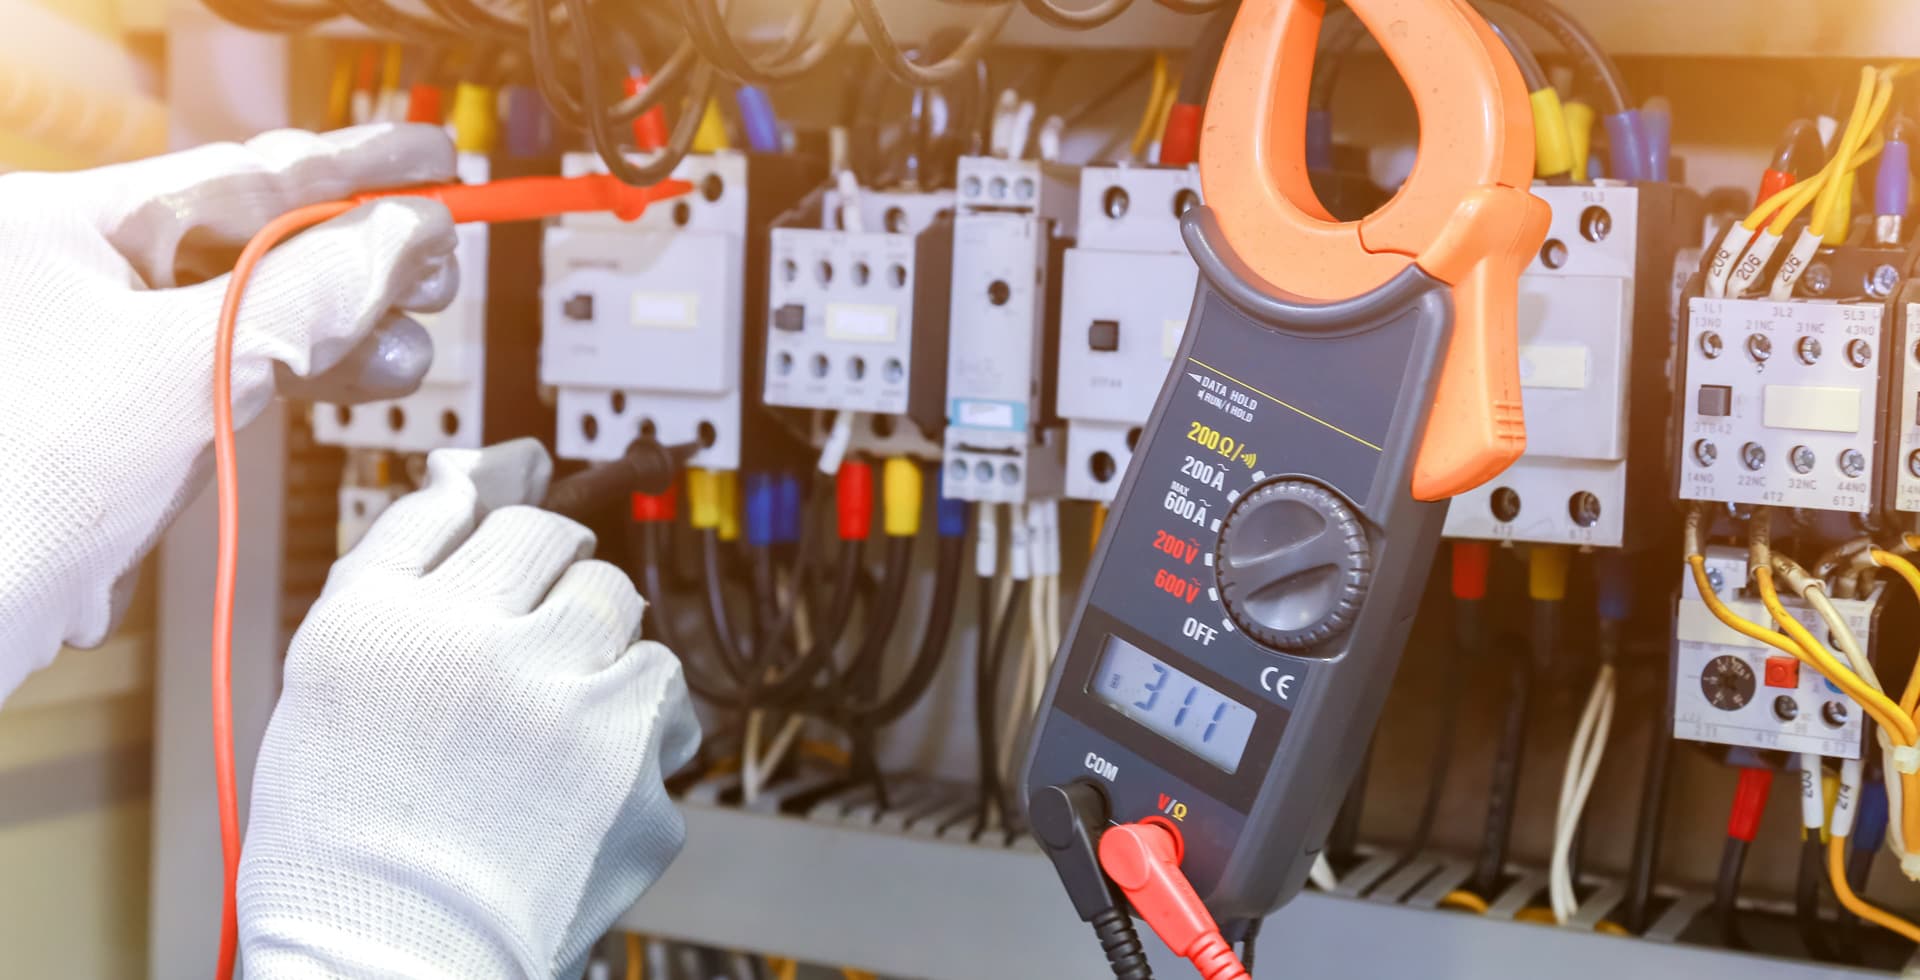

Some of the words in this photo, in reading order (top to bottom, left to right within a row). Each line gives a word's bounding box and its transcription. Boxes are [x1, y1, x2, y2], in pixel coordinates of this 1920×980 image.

[1736, 253, 1761, 281] 206
[1843, 309, 1866, 321] 5L3
[1201, 376, 1228, 397] DATA
[1229, 389, 1258, 411] HOLD
[1230, 405, 1254, 423] HOLD
[1171, 480, 1190, 495] MAX
[1737, 475, 1768, 487] 22NC
[1787, 478, 1818, 490] 32NC
[1762, 491, 1785, 503] 4T2
[1182, 617, 1218, 646] OFF
[1260, 666, 1296, 700] CE
[1133, 662, 1229, 743] 311
[1084, 752, 1119, 782] COM
